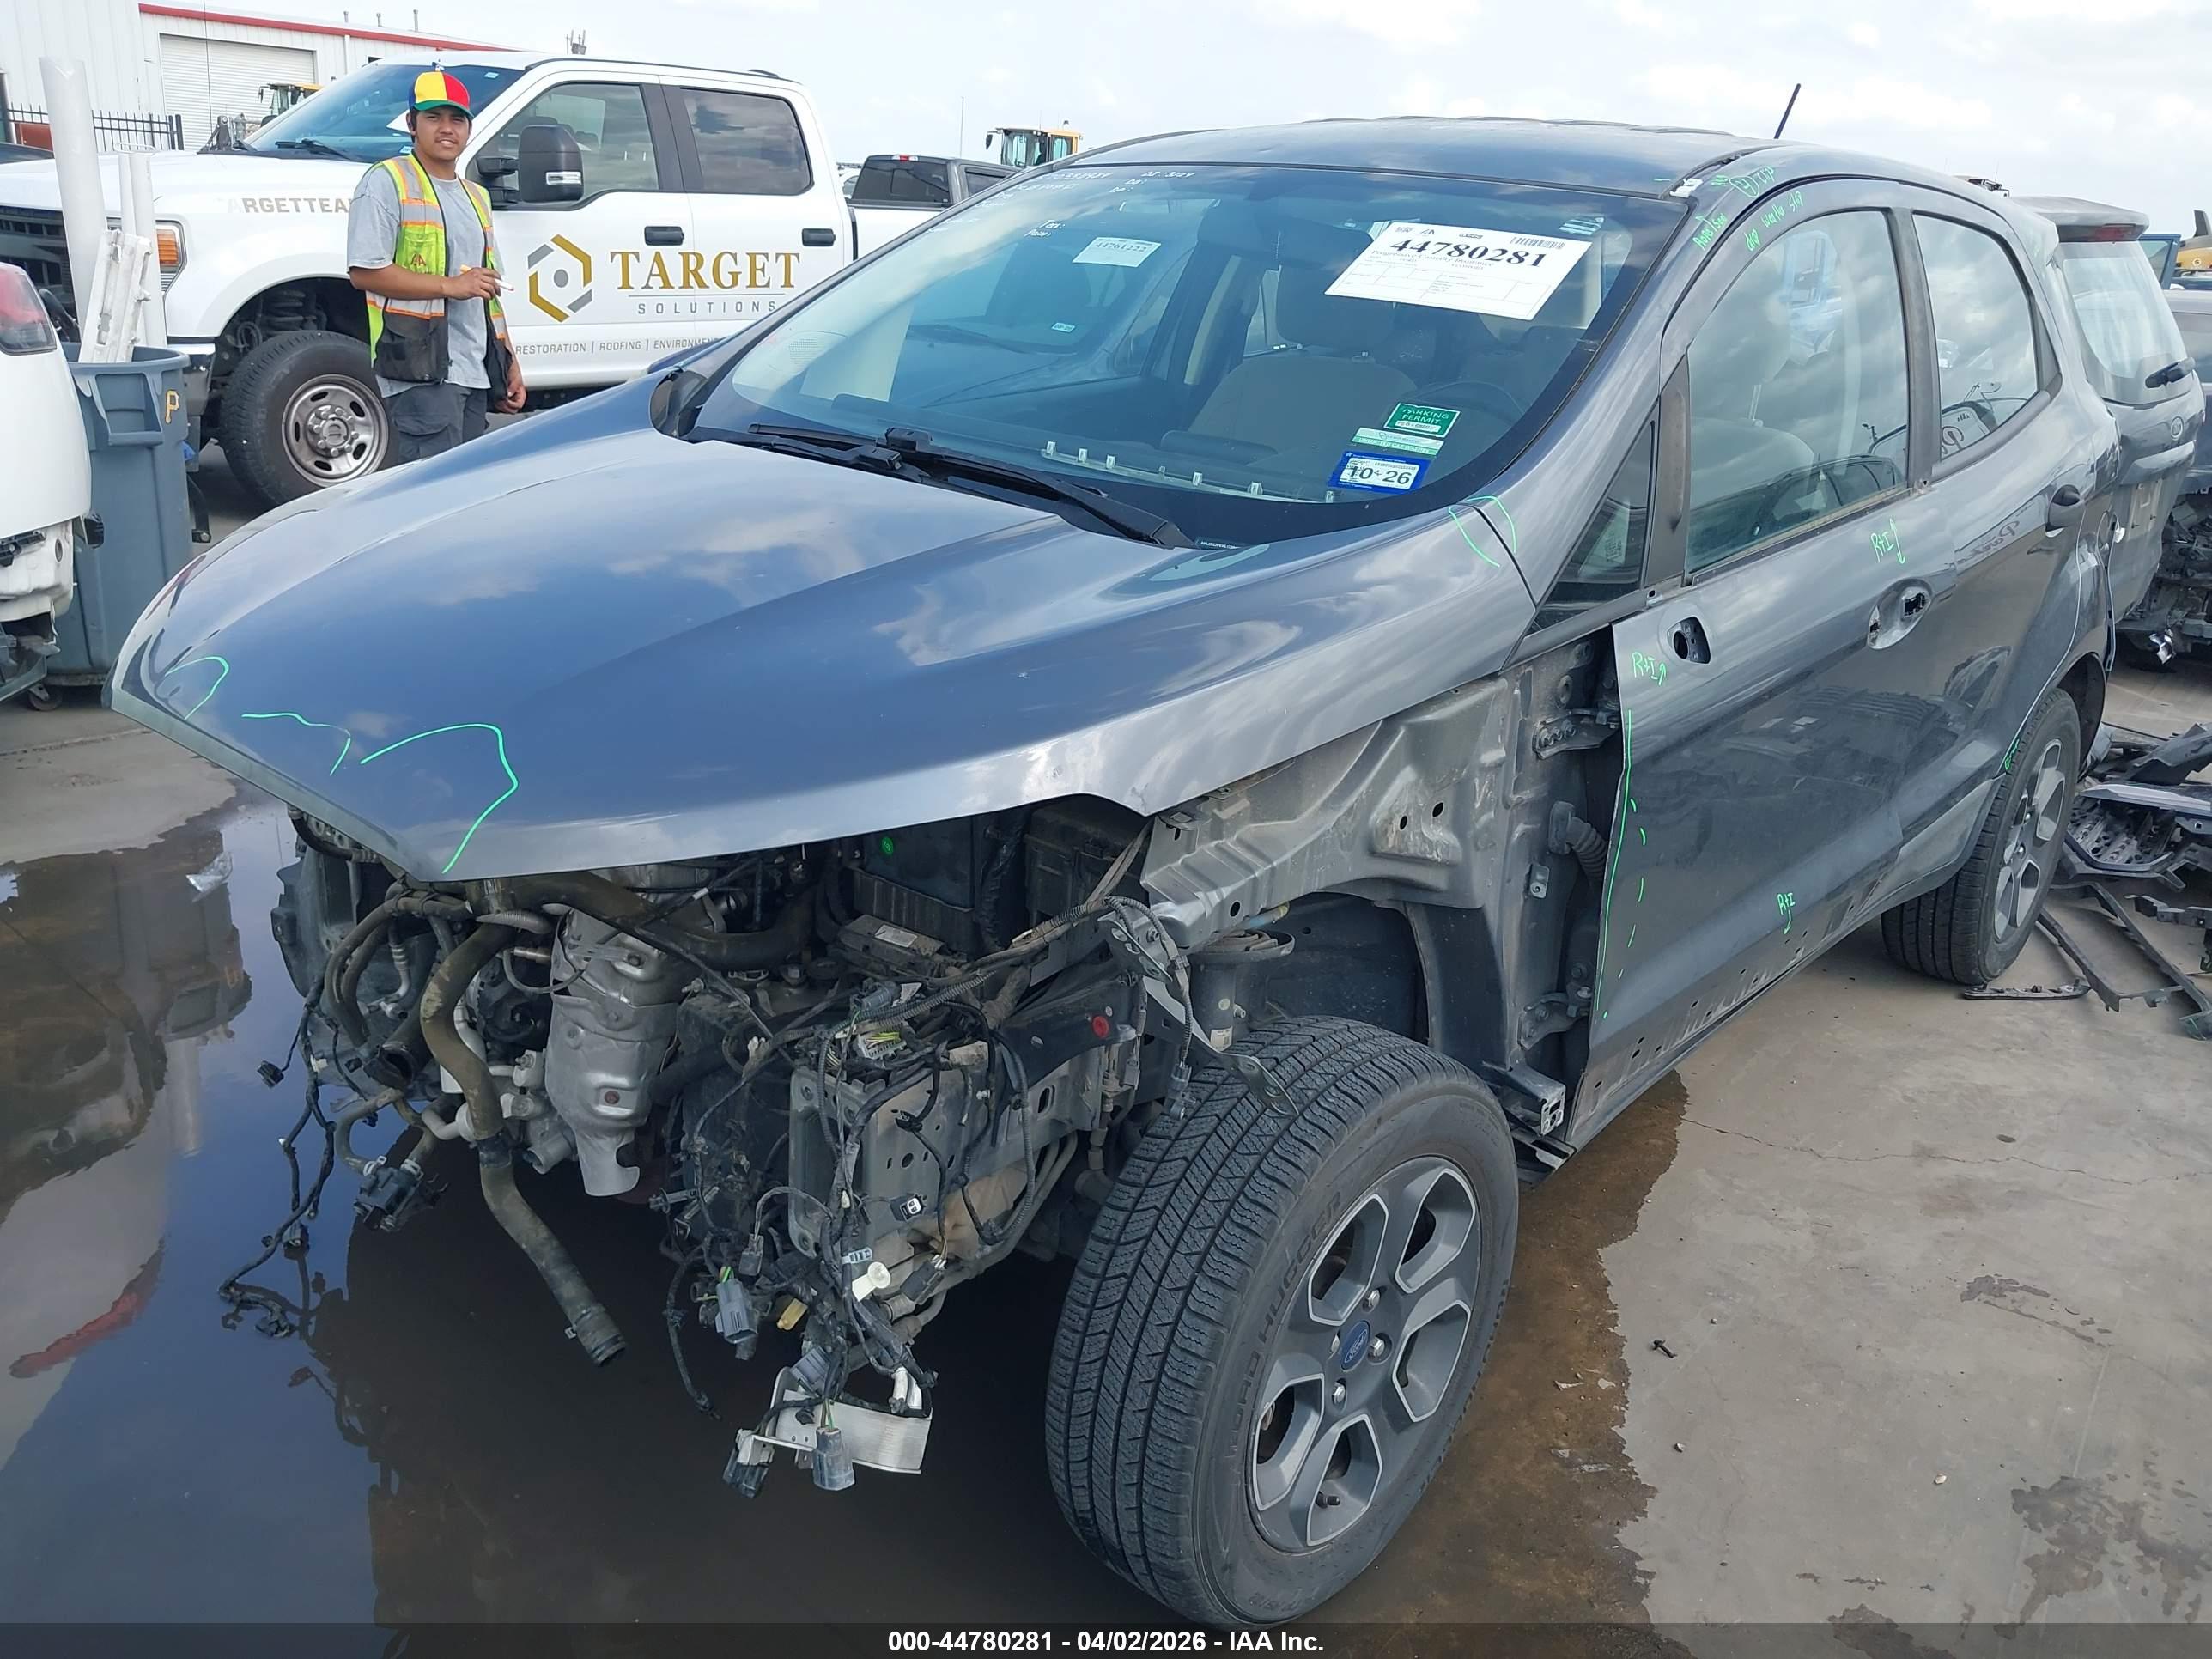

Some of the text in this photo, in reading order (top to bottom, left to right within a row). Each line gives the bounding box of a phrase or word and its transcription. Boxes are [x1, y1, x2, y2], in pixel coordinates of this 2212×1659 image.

[228, 198, 351, 213] ARGETTEA
[1390, 239, 1547, 267] 44780281
[611, 251, 800, 289] TARGET
[637, 300, 776, 315] SOLUTIONS
[515, 337, 721, 355] RESTORATION ROOFING ENVIRONM
[165, 389, 179, 424] P
[1402, 408, 1449, 420] PARKING
[1401, 414, 1442, 424] PERMIT
